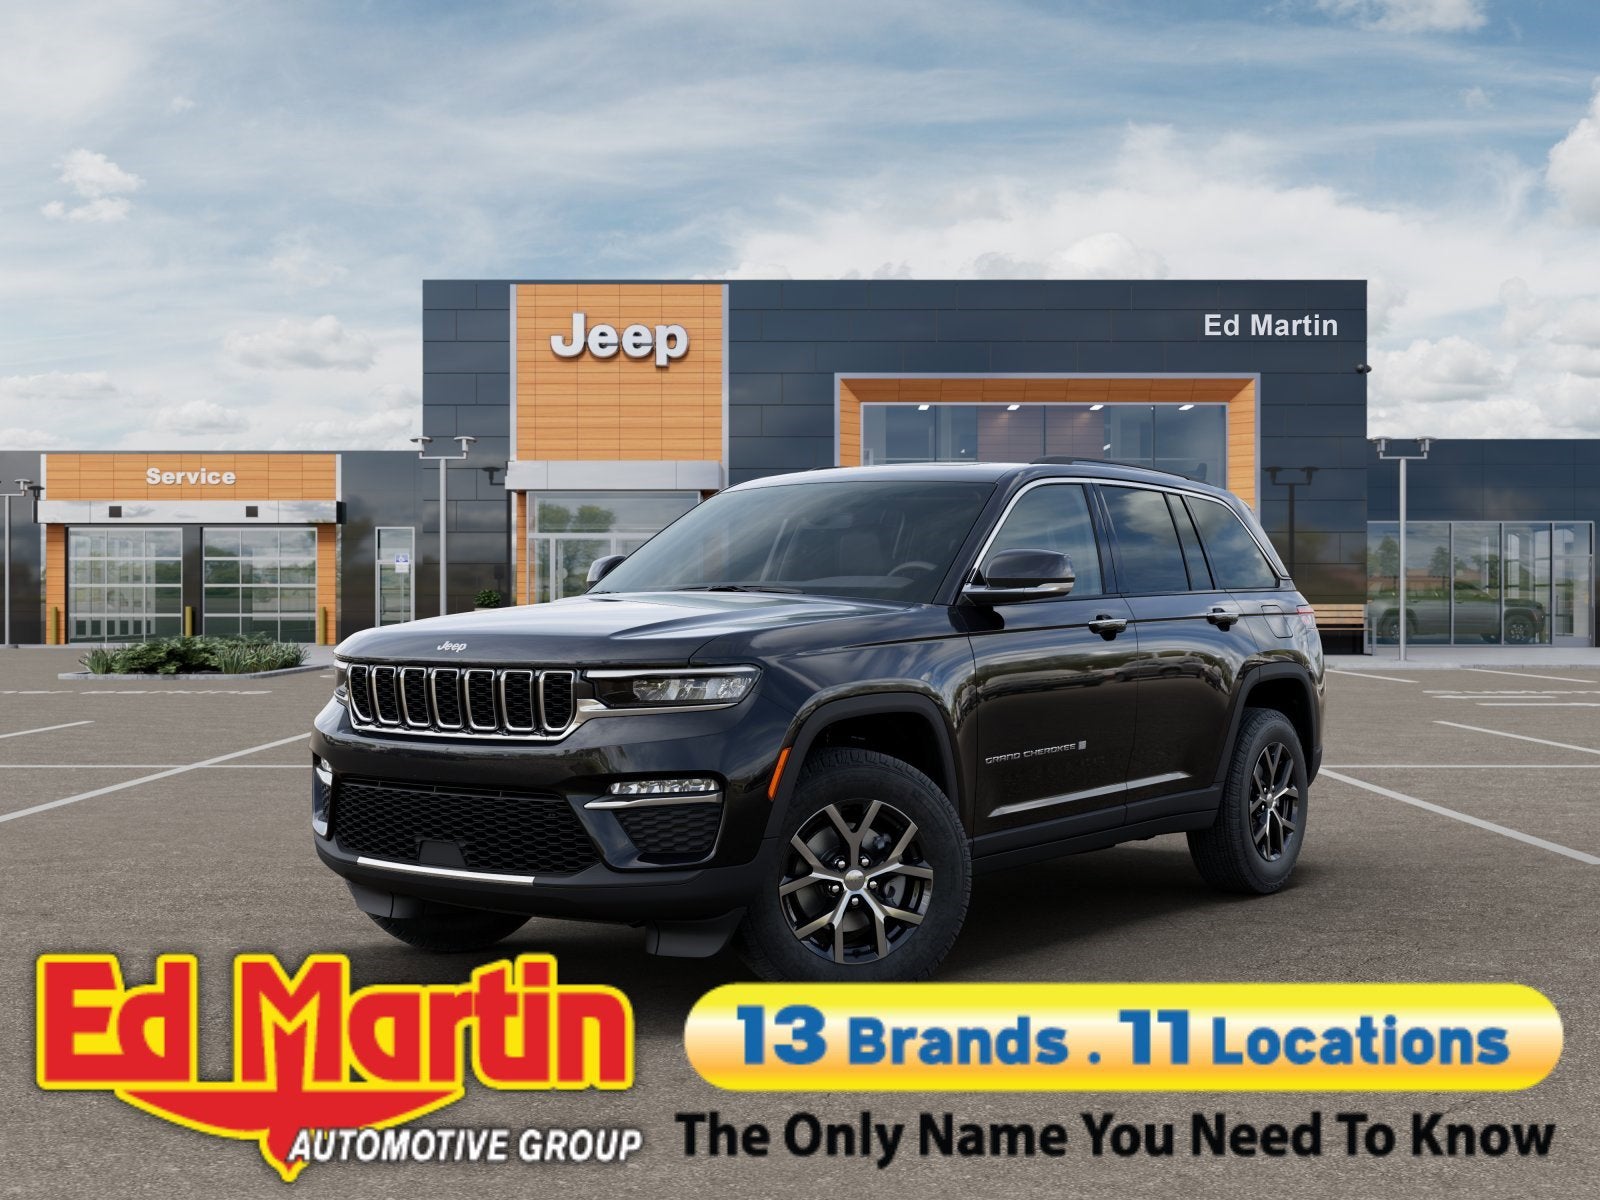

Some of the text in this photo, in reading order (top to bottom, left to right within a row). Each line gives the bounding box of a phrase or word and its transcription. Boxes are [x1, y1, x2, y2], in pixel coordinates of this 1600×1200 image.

[1204, 314, 1338, 336] Ed Martin
[550, 312, 689, 368] Jeep
[146, 467, 236, 485] Service
[437, 641, 467, 653] Jeep
[985, 743, 1076, 764] GRAND CHEROKEE
